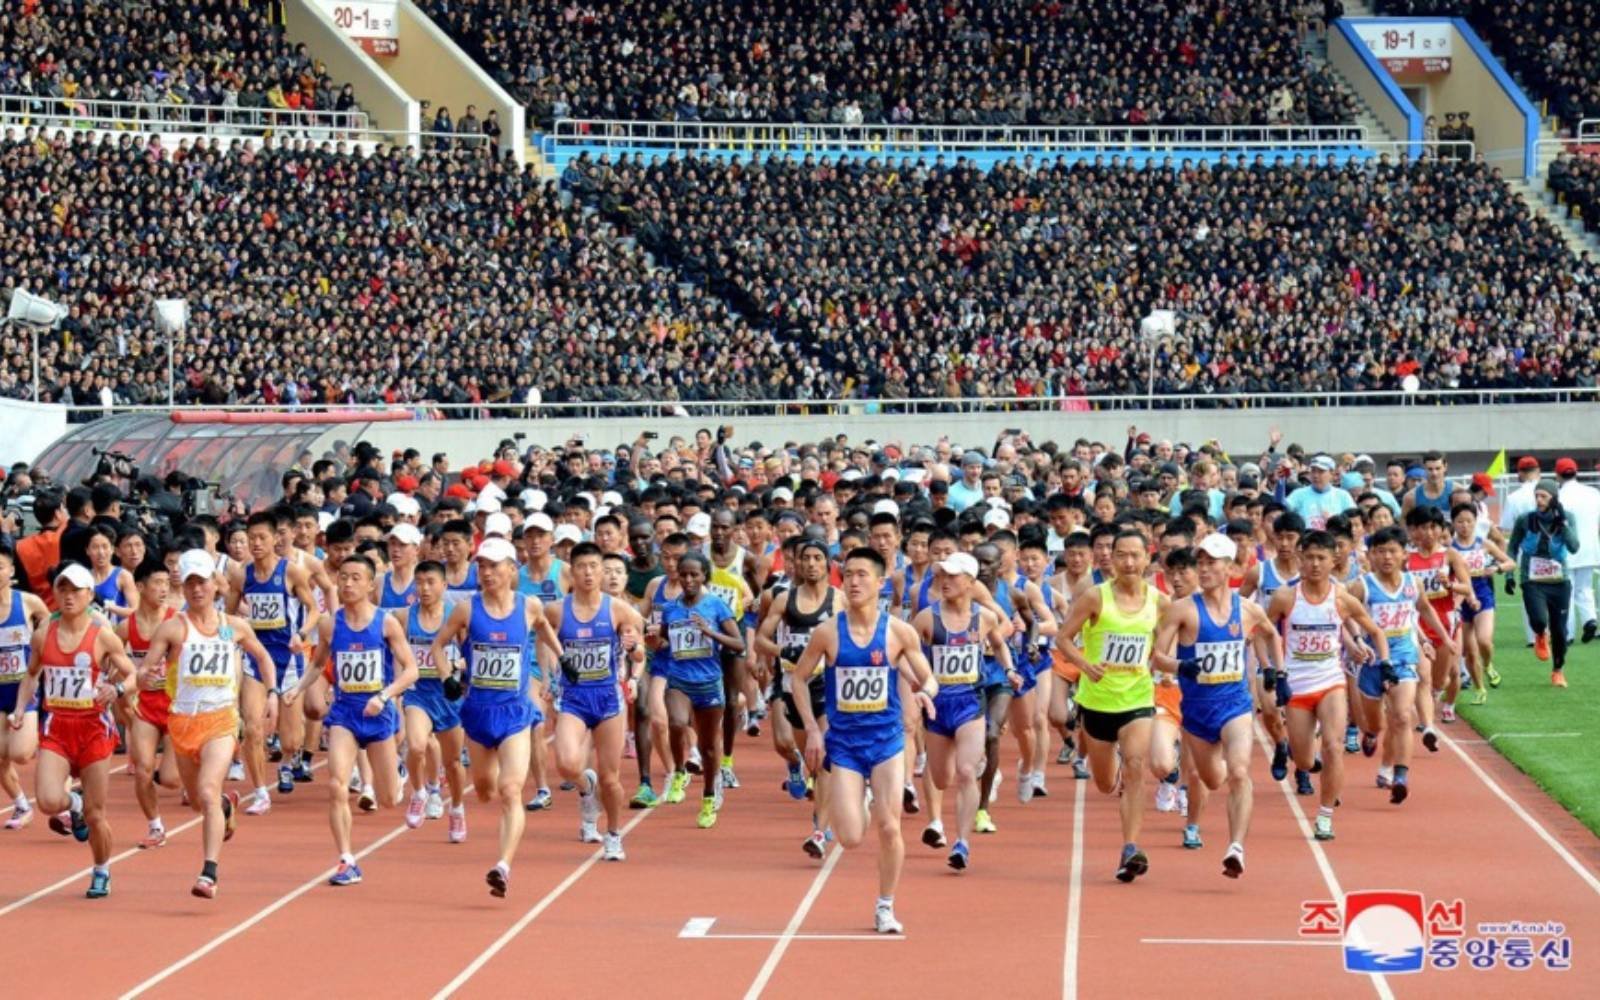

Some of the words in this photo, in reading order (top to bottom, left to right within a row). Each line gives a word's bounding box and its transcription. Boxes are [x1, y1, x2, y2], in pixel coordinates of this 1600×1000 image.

[334, 6, 369, 29] 20-1
[1382, 29, 1415, 50] 19-1
[251, 602, 279, 620] 052
[1106, 642, 1145, 665] 1101
[1298, 634, 1331, 653] 356
[189, 652, 229, 675] 041
[341, 660, 377, 682] 001
[477, 657, 516, 679] 002
[571, 651, 607, 670] 005
[939, 654, 974, 675] 100
[1202, 650, 1240, 674] 011
[841, 677, 884, 702] 009
